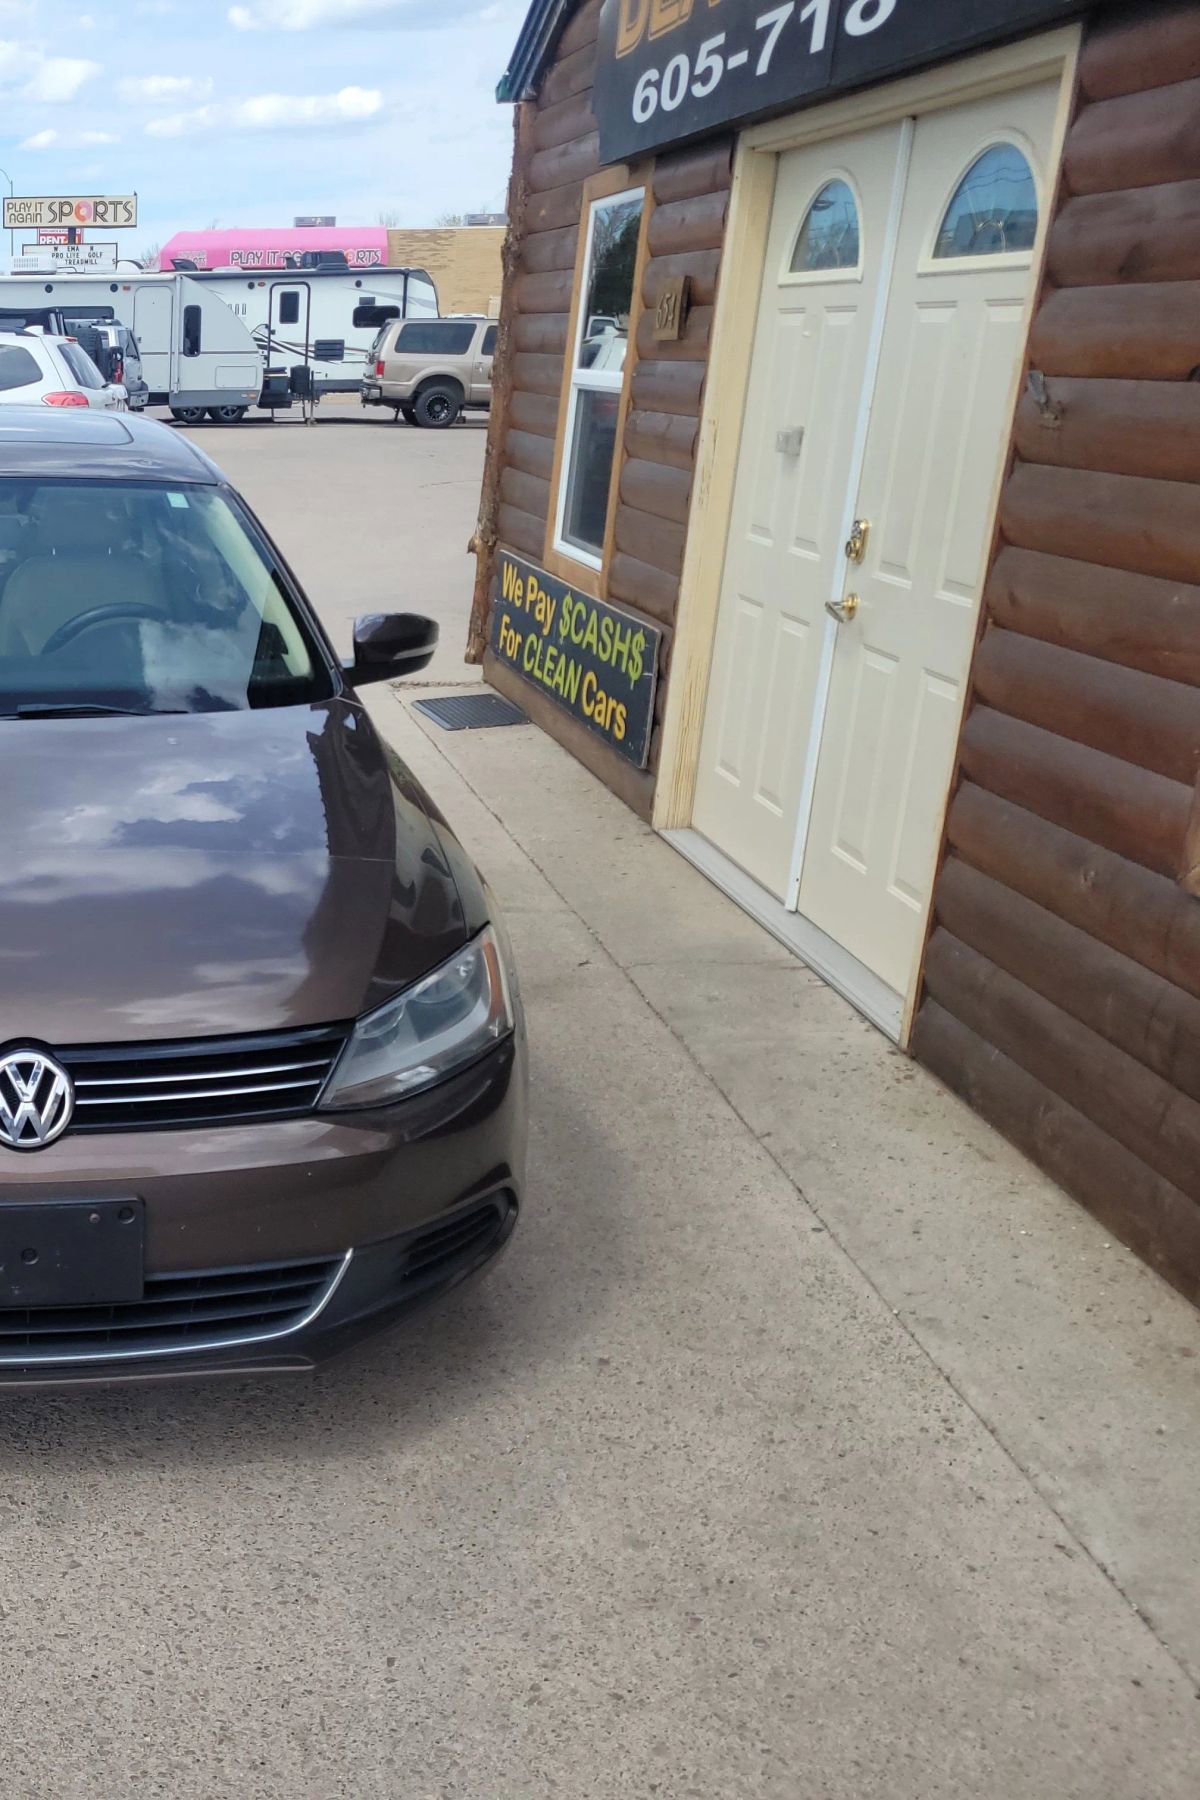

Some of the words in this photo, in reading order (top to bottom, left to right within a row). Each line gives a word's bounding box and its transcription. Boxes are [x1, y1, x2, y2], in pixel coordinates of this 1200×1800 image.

[6, 202, 32, 213] PLAY
[34, 202, 44, 212] IT
[47, 200, 133, 223] SPORTS
[9, 213, 43, 223] AGAIN
[230, 250, 263, 265] PLAY
[266, 250, 280, 265] IT
[502, 560, 524, 608] We
[525, 575, 556, 636] Pay
[559, 590, 646, 690] $CASH$
[499, 614, 522, 661] For
[523, 632, 583, 704] CLEAN
[581, 670, 627, 740] Cars
